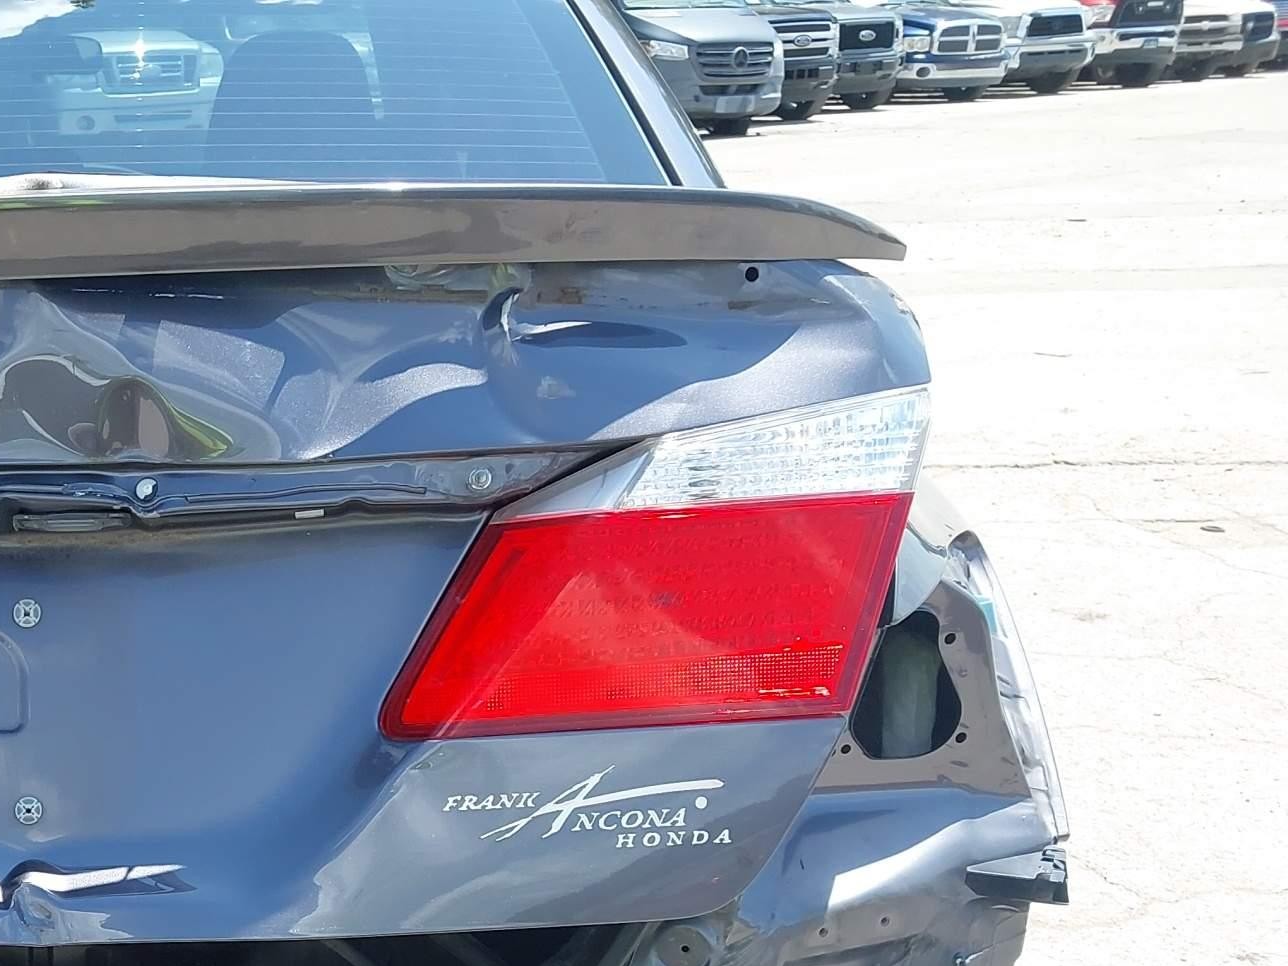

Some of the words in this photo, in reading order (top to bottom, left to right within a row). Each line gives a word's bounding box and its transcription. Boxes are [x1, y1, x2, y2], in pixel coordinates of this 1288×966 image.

[443, 791, 540, 812] FRANK
[480, 764, 724, 842] ANCONA
[615, 829, 732, 849] HONDA
